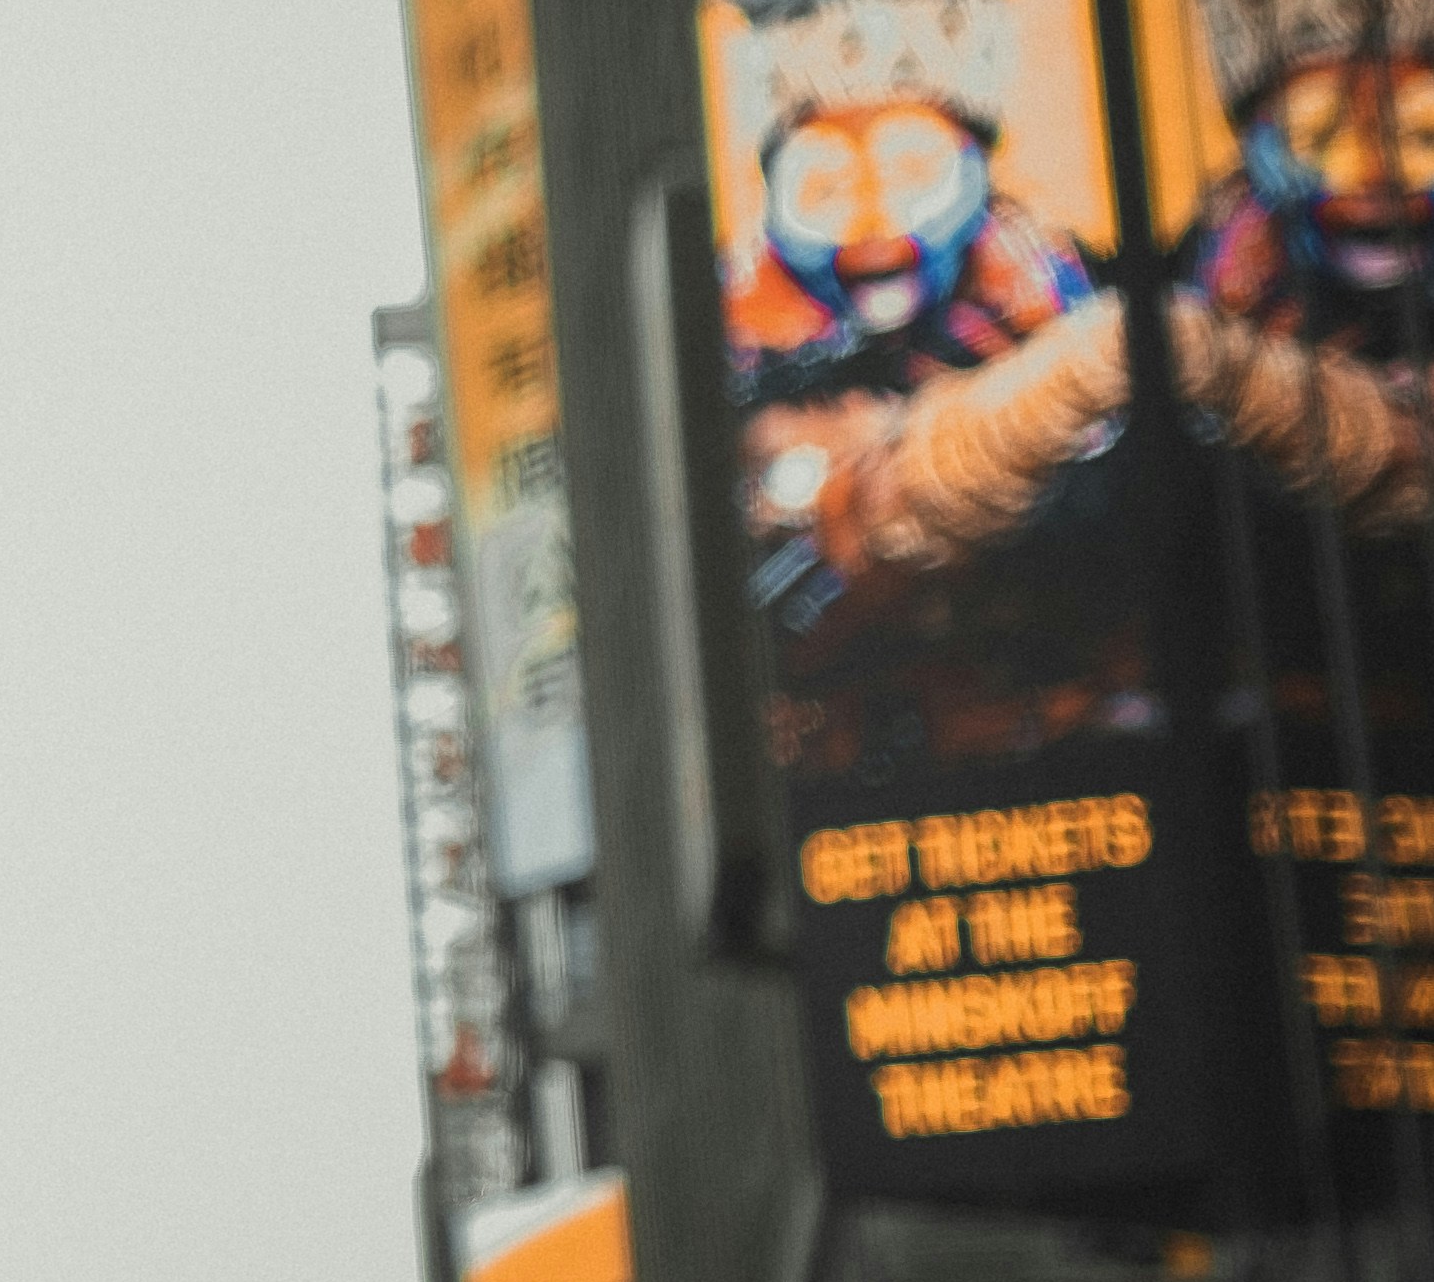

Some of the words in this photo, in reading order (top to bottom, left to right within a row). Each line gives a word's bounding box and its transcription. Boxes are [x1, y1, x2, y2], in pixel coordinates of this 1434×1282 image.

[801, 821, 910, 903] GET
[914, 793, 1152, 890] TICKETS
[886, 896, 962, 976] AT
[965, 882, 1083, 966] THE
[847, 960, 1137, 1061] MINSKOFF
[872, 1043, 1132, 1139] THEATRE
